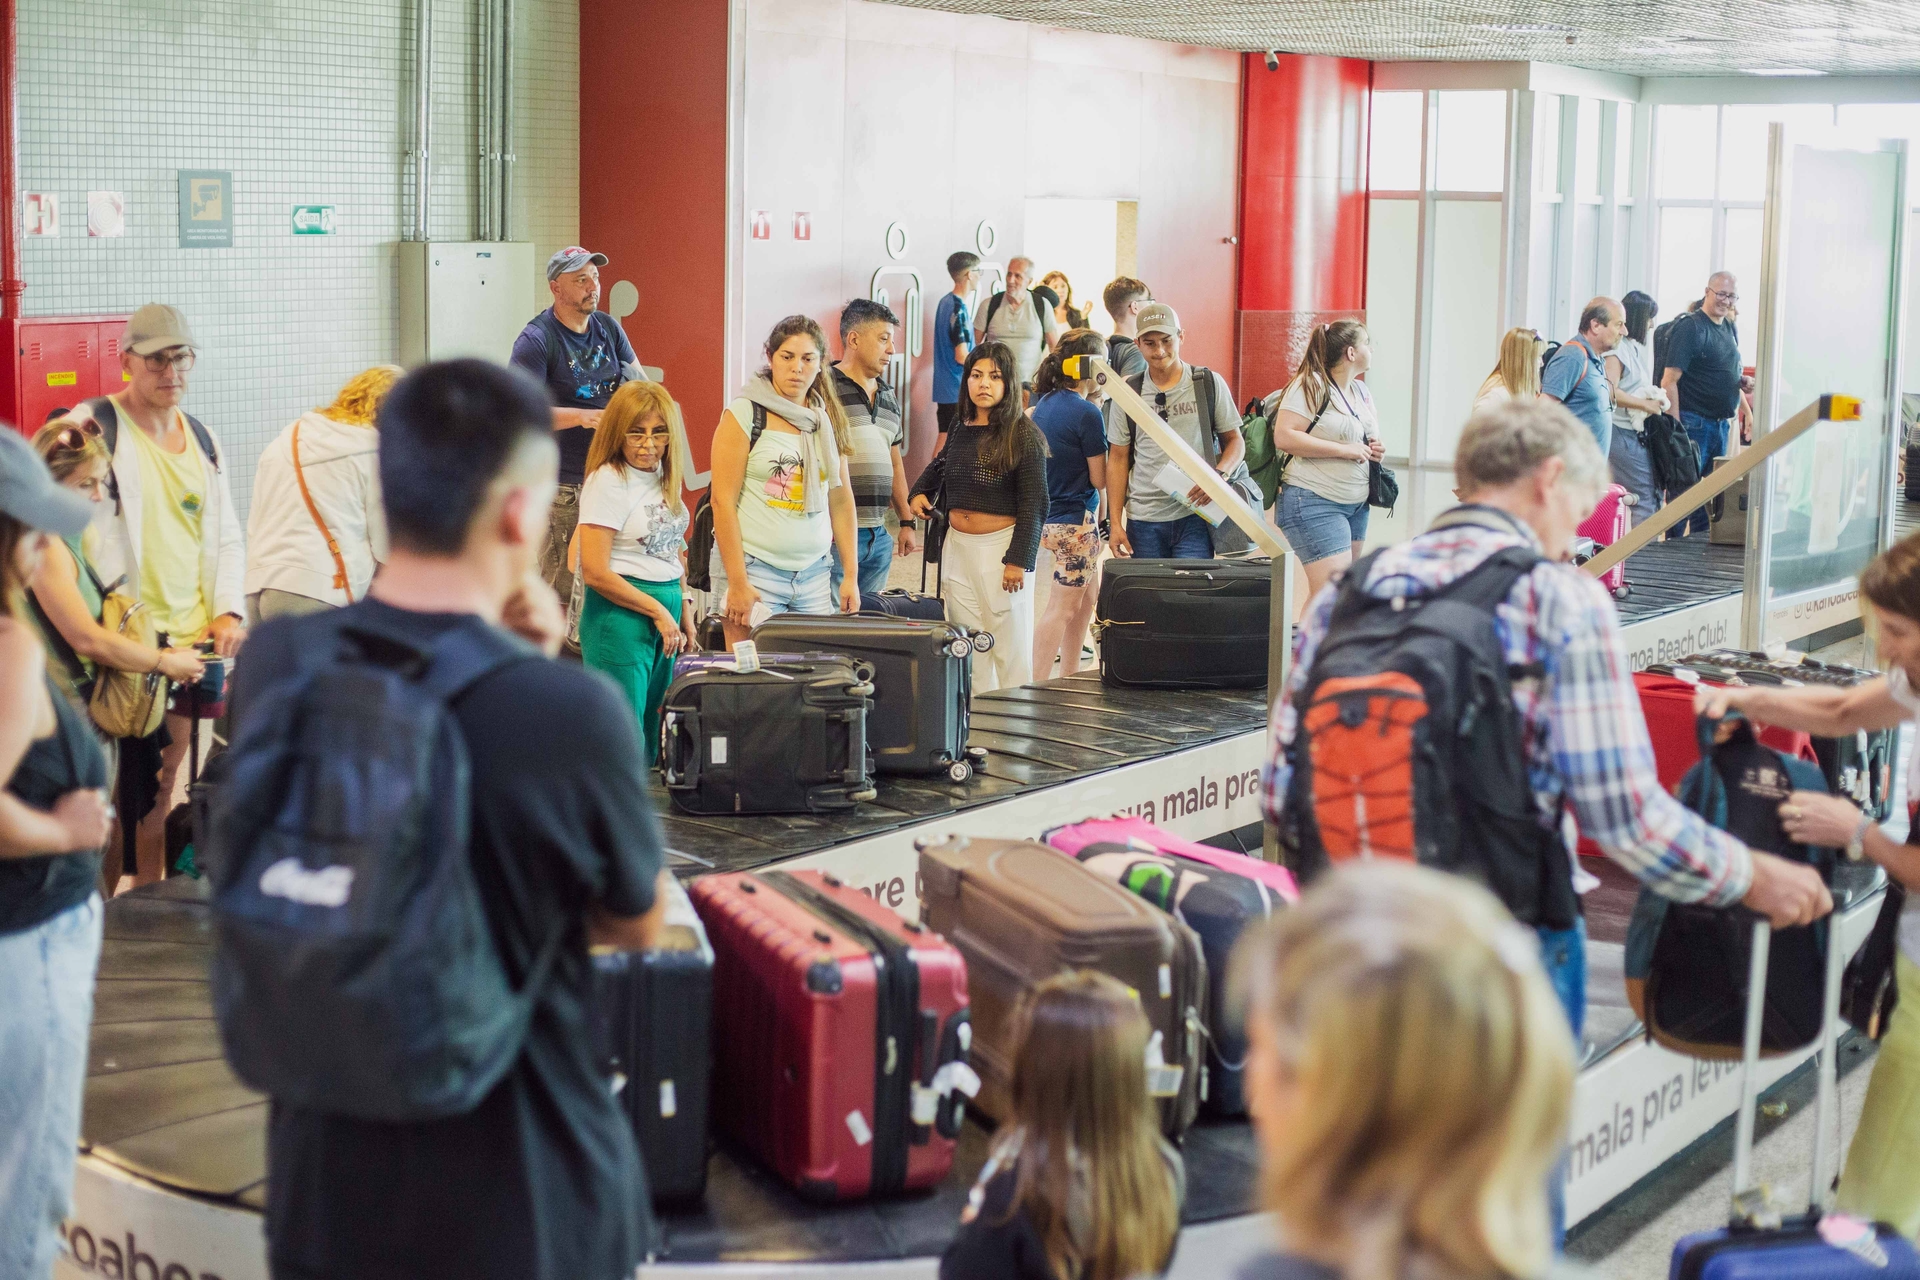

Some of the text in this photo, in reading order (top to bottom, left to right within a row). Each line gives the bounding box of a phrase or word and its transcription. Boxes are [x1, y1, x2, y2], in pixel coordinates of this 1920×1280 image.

[1143, 314, 1160, 322] CASE
[1173, 401, 1197, 416] SKAT
[1627, 619, 1728, 671] noa Beach Club!
[1163, 776, 1218, 822] mala
[1225, 768, 1262, 810] pra
[859, 876, 905, 908] re
[1568, 1101, 1635, 1184] mala
[1642, 1073, 1684, 1144] pra
